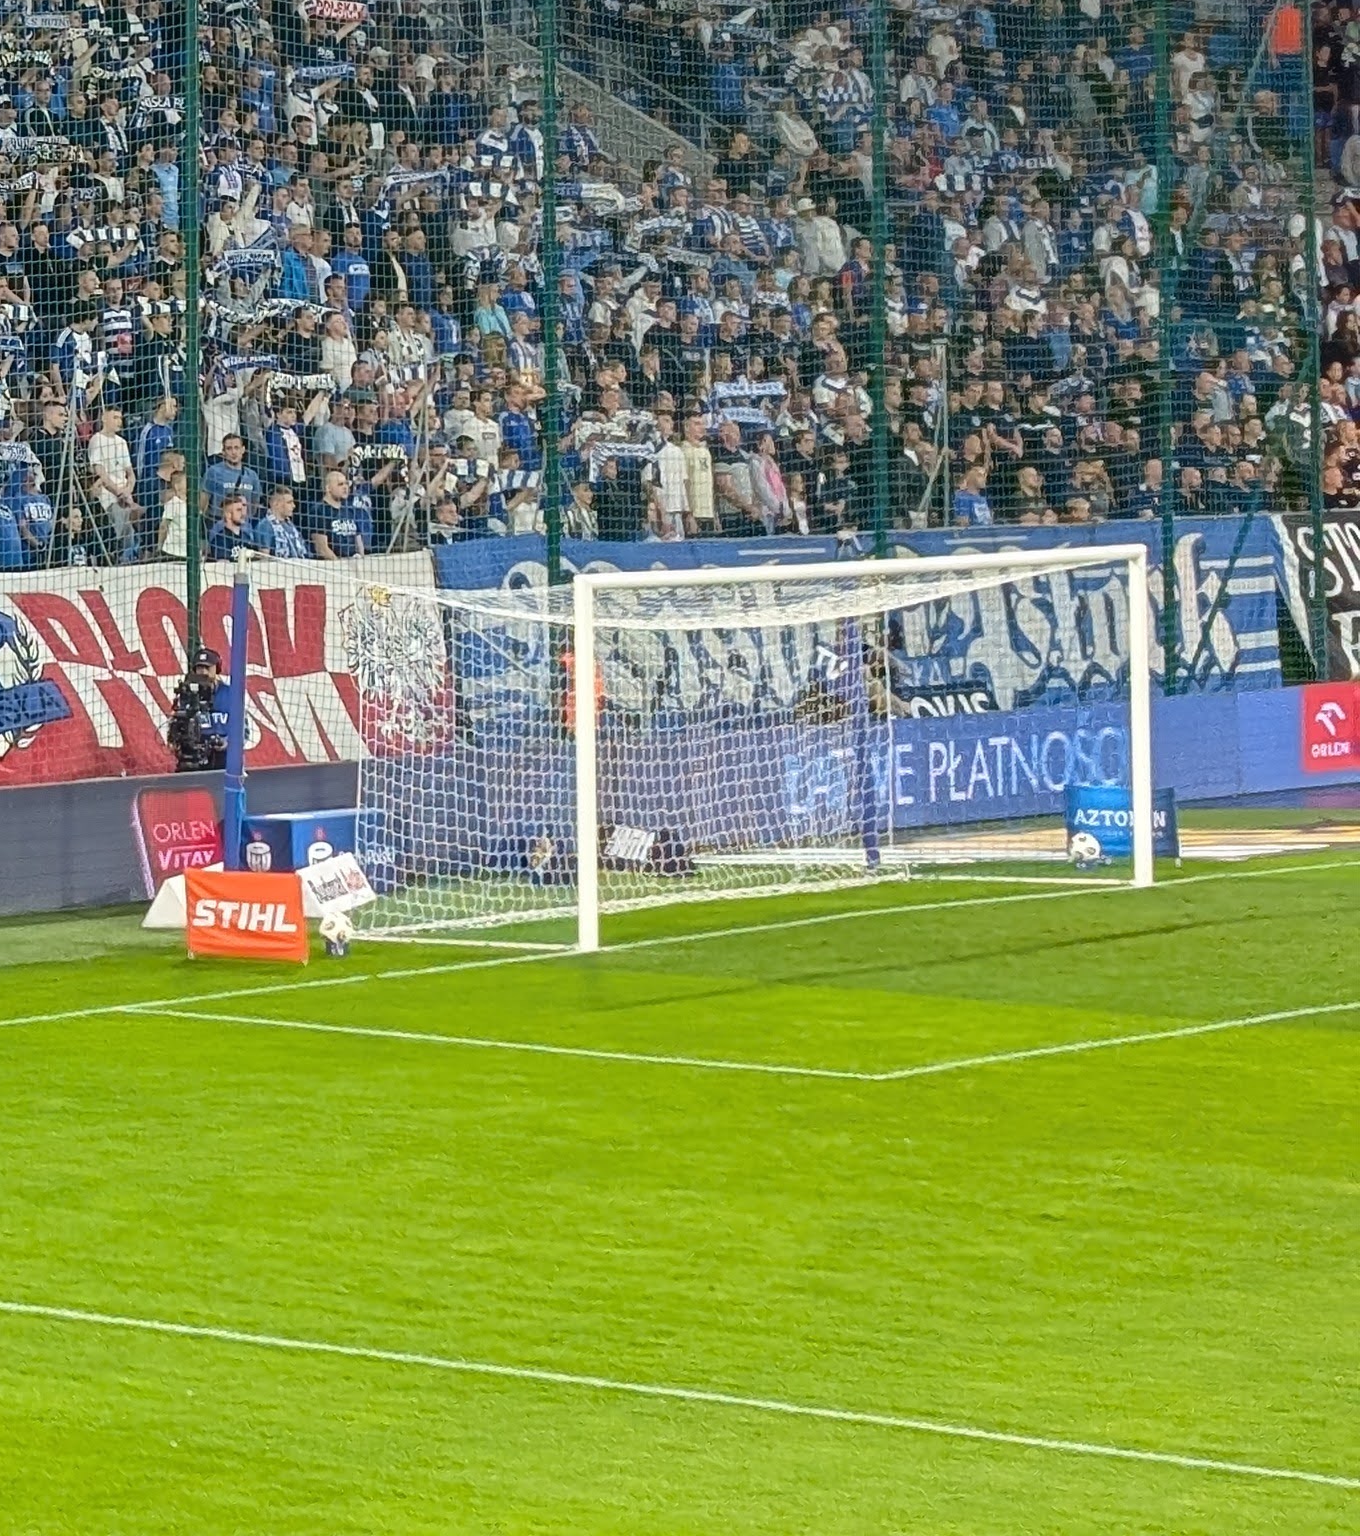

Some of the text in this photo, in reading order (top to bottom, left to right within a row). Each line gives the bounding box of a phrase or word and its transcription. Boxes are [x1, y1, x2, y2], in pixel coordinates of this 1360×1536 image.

[315, 0, 364, 19] POLSKA
[153, 820, 216, 843] ORLEN
[192, 899, 297, 932] STIHL
